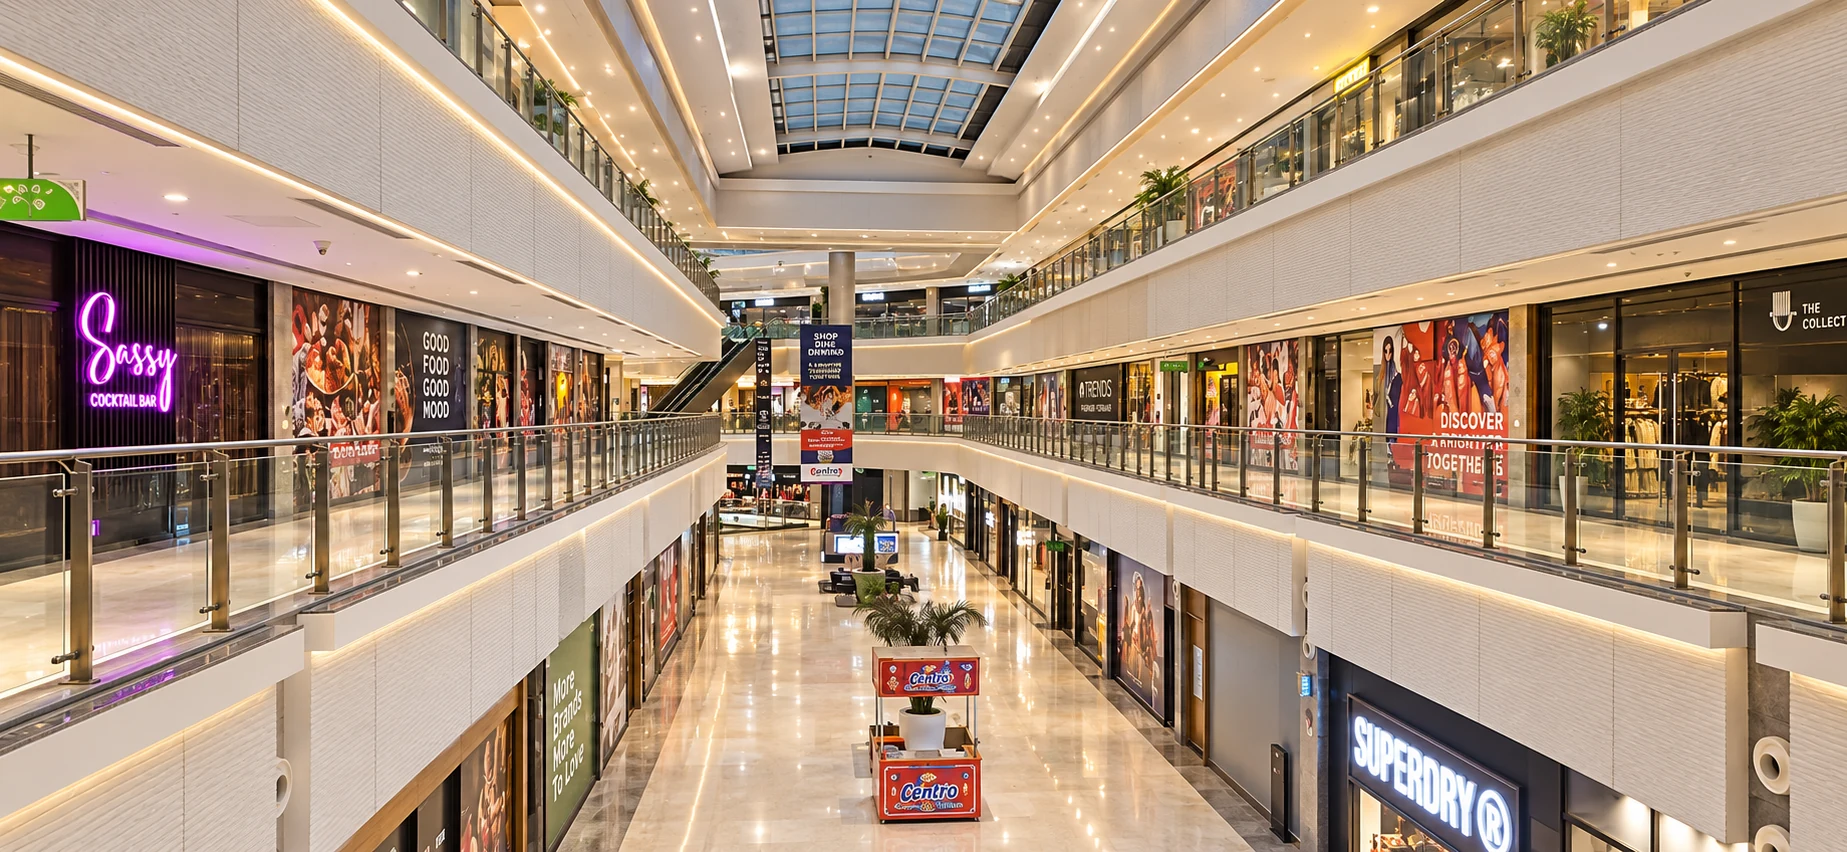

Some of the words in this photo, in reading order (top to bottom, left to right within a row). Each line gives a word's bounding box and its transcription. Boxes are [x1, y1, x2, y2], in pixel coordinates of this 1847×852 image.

[1802, 302, 1821, 315] THE
[1802, 315, 1847, 330] COLLECT
[79, 291, 178, 413] Sassy
[422, 331, 450, 354] GOOD
[422, 354, 450, 376] FOOD
[422, 377, 450, 398] GOOD
[90, 393, 138, 408] COCKTAIL
[139, 394, 158, 408] BAR
[422, 400, 450, 419] MOOD
[1440, 411, 1504, 431] DISCOVER
[553, 670, 575, 710] More
[908, 671, 951, 687] Centro
[553, 688, 582, 742] Brands
[553, 728, 575, 773] More
[552, 773, 564, 803] To
[565, 743, 584, 786] Love
[1353, 715, 1478, 838] SUPERDRY
[900, 782, 960, 804] Centro
